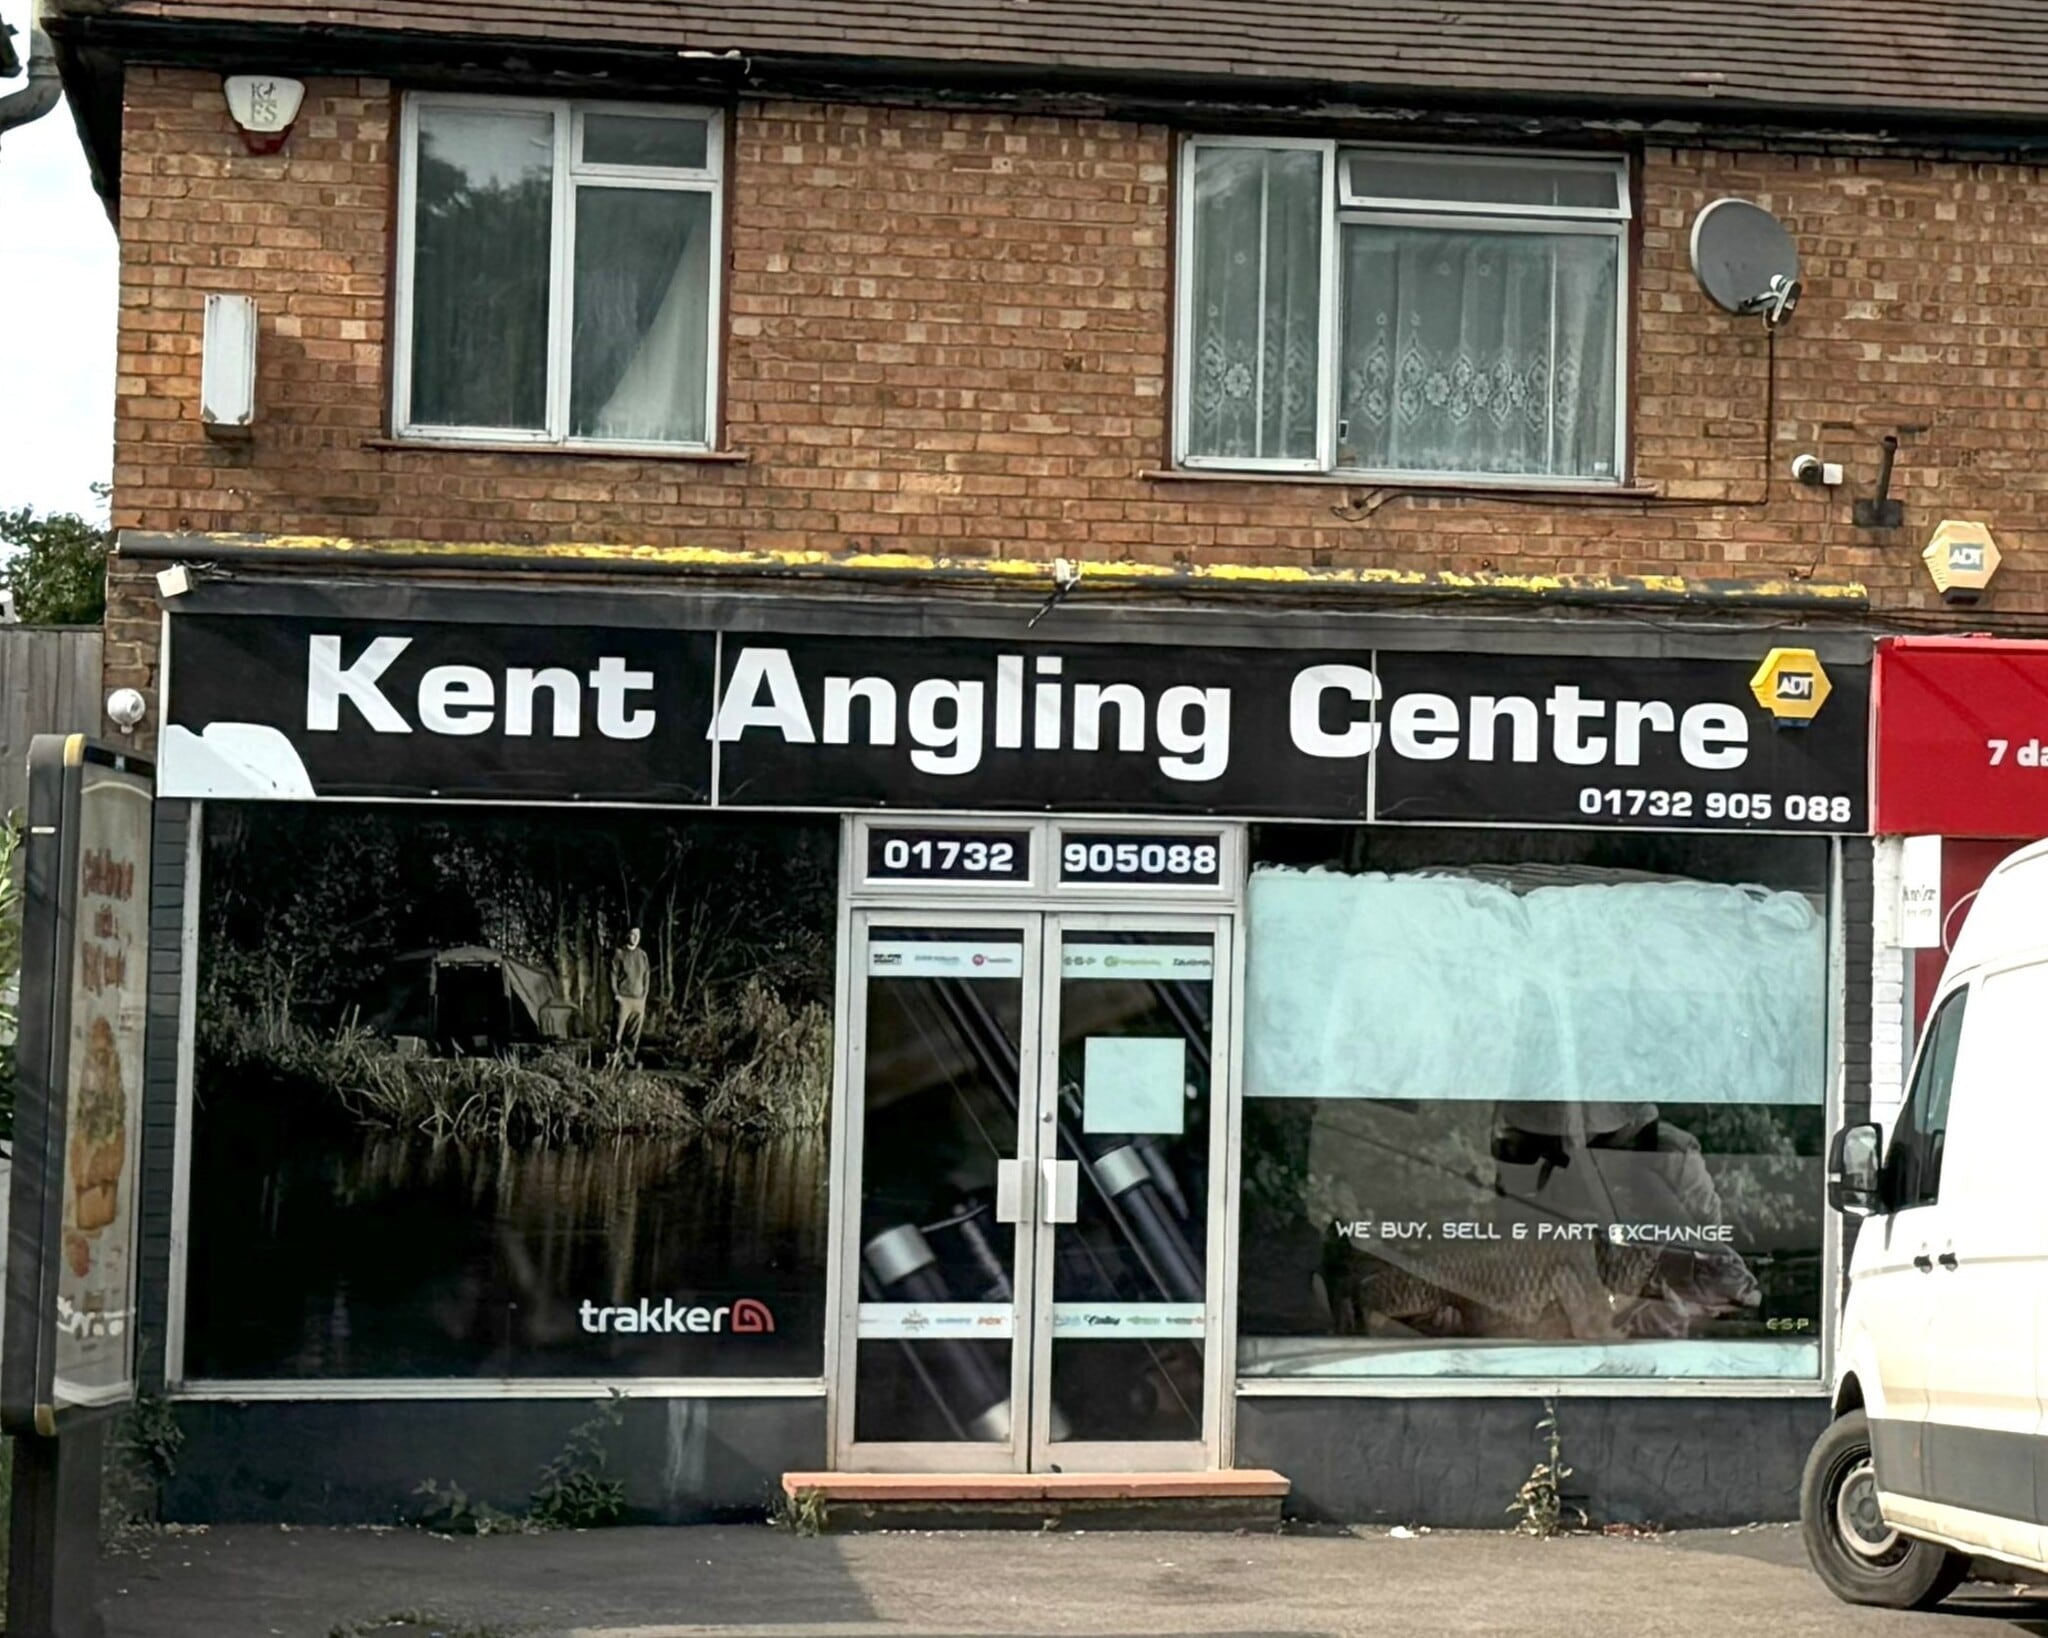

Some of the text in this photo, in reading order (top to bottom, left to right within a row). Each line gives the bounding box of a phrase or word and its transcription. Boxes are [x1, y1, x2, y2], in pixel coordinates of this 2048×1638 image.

[1949, 547, 1984, 566] ADT
[1777, 675, 1814, 696] ADT
[306, 634, 1749, 781] Kent Angling Centre
[1987, 739, 2009, 766] 7
[1579, 787, 1851, 823] 01732 905 088
[884, 839, 1014, 872] 01732
[1064, 843, 1216, 874] 905088
[1335, 1221, 1734, 1242] WE BUY, SELL & PART EXCHANGE
[579, 1297, 730, 1333] trakker
